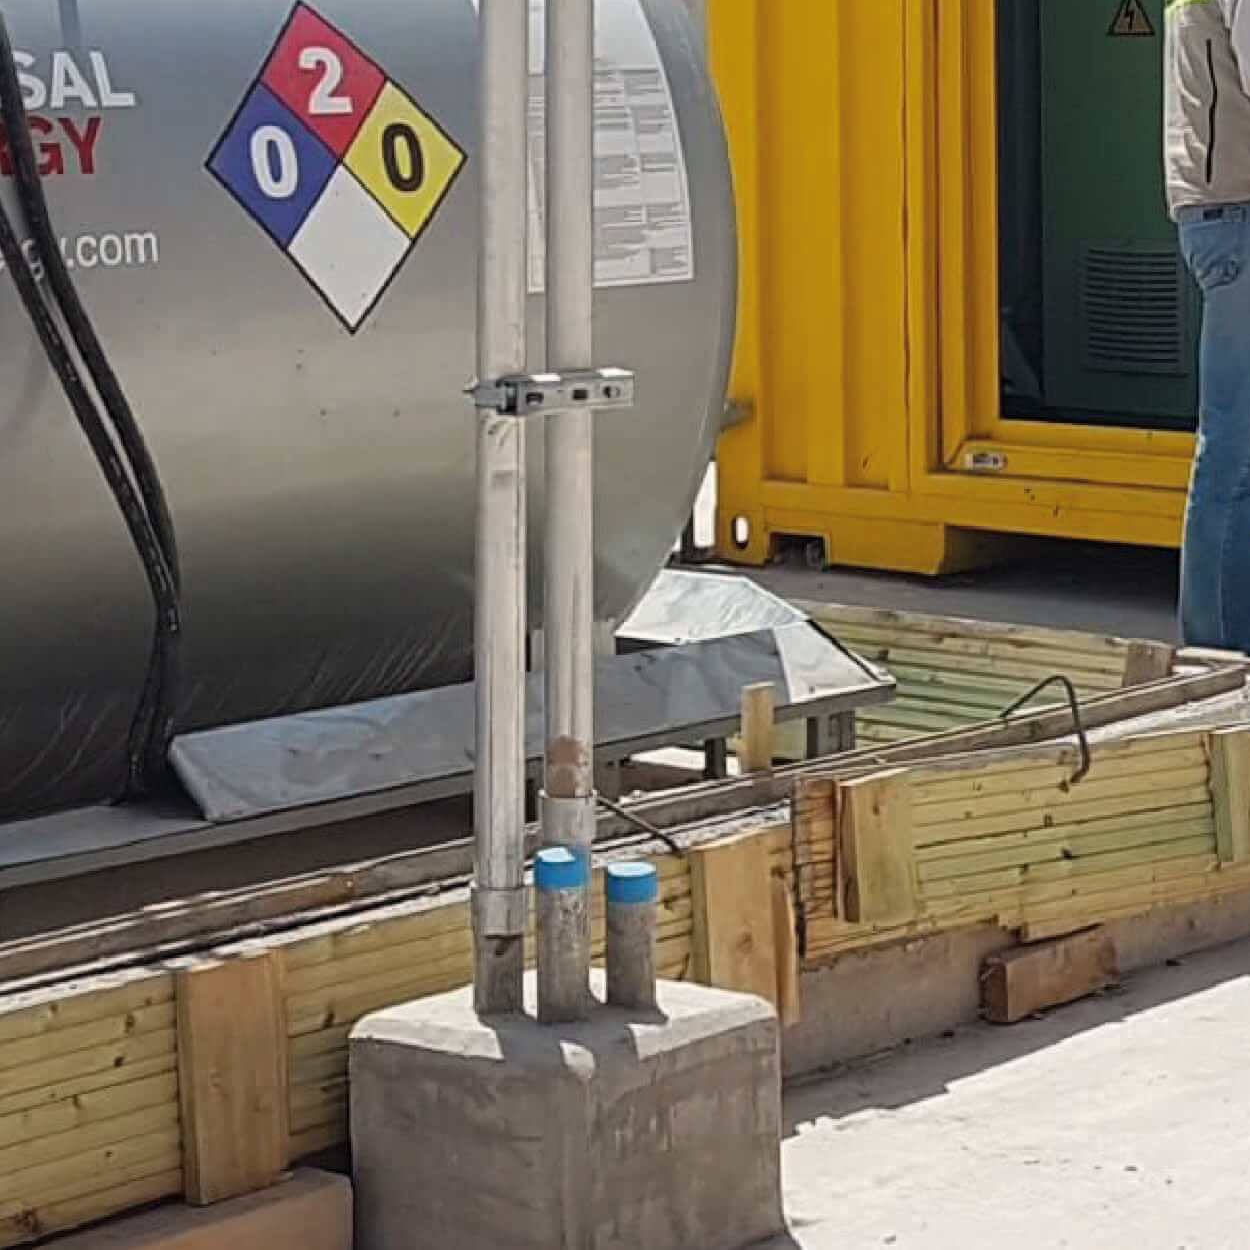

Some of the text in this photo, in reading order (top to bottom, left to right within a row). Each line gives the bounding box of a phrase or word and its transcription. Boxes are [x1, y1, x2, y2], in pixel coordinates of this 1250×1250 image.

[299, 48, 354, 115] 2
[250, 126, 298, 198] 0
[381, 123, 424, 192] 0
